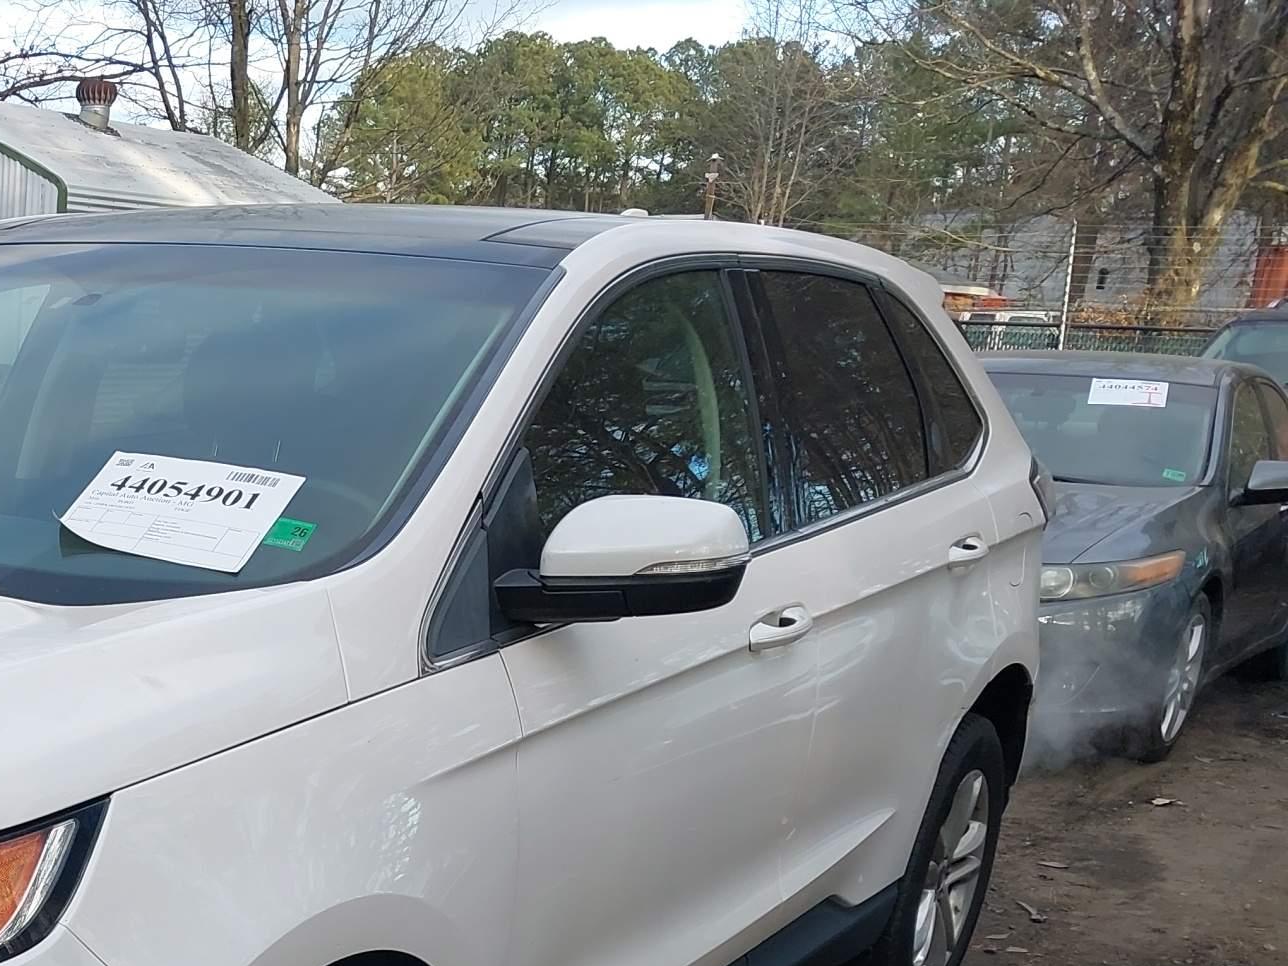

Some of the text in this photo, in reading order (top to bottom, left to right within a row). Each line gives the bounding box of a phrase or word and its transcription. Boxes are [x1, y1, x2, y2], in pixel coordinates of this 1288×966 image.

[110, 475, 261, 510] 44054901
[120, 491, 139, 500] Auto
[140, 494, 172, 506] Auction
[291, 526, 309, 538] 26
